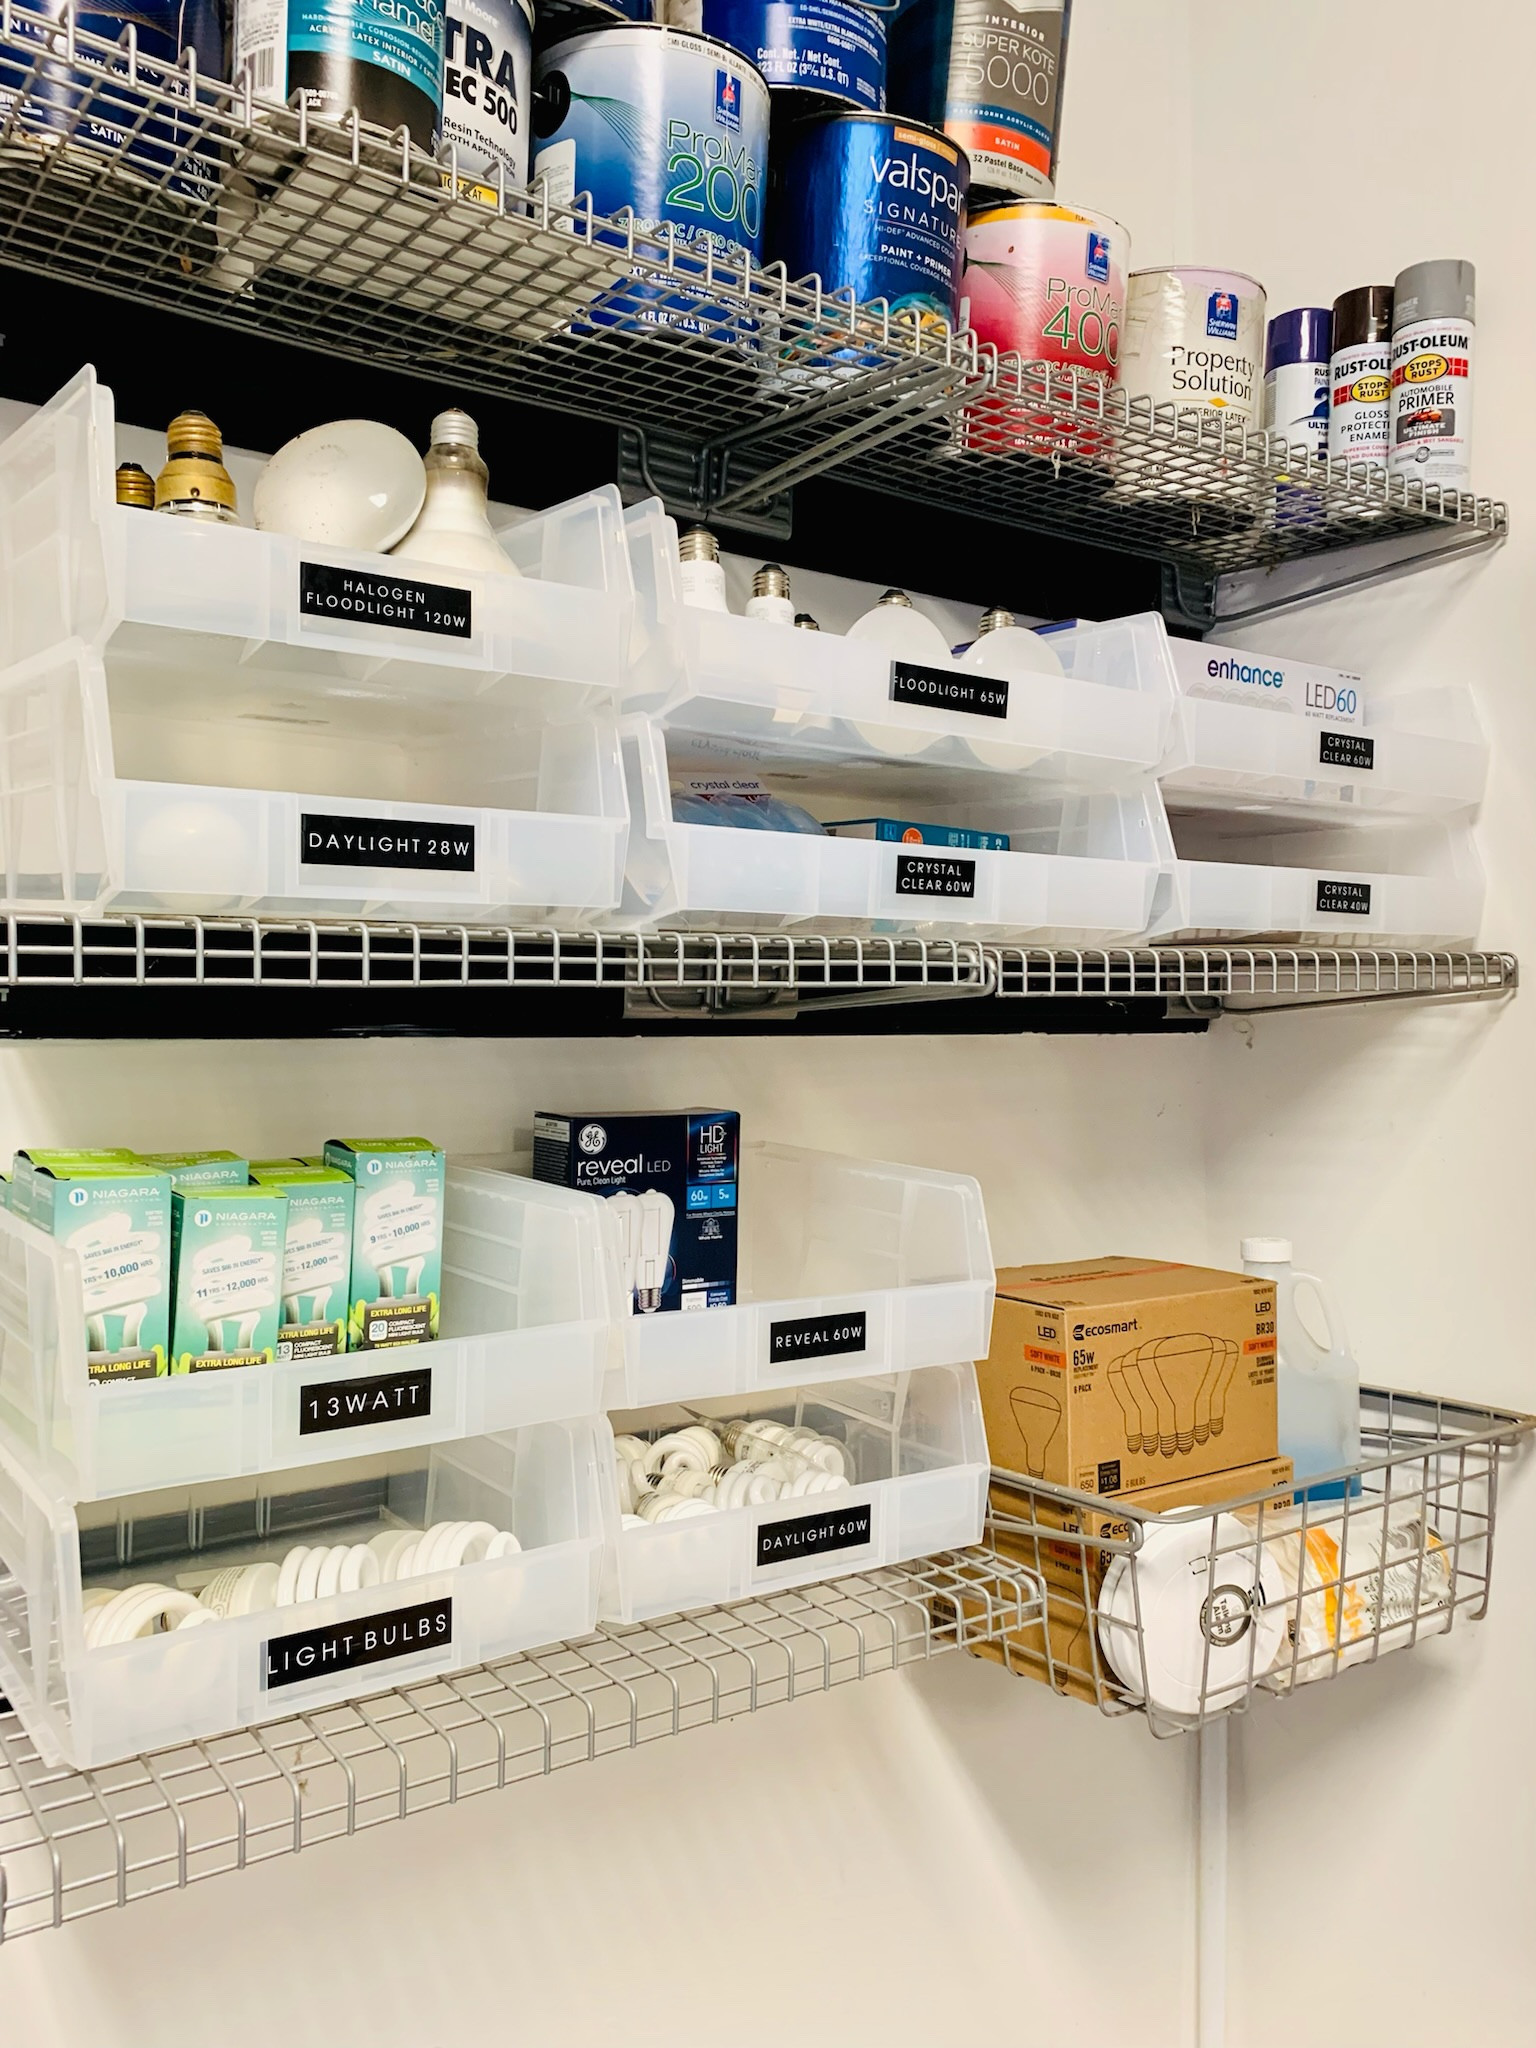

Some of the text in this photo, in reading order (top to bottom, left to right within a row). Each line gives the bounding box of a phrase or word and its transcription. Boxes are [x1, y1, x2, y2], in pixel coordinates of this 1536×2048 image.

[464, 1, 499, 28] Moore
[985, 14, 1045, 42] INTERIOR
[351, 31, 418, 67] LATEX INTERIOR
[961, 32, 1055, 76] SUPER KOTE
[372, 50, 411, 78] SATIN
[757, 47, 779, 60] Cont.
[782, 48, 800, 60] Net.
[807, 51, 822, 62] Net
[823, 53, 842, 70] Cont.
[775, 61, 784, 72] FL
[787, 62, 797, 73] OZ
[820, 66, 836, 81] U.S.
[963, 53, 1049, 106] 5000
[483, 84, 518, 136] 500
[443, 116, 517, 170] Resin Technology
[897, 131, 937, 150] semi-gloss
[995, 137, 1021, 151] SATIN
[984, 155, 1007, 169] Pastel
[1008, 162, 1024, 174] Base
[869, 153, 965, 217] valspar
[665, 153, 760, 239] 200
[863, 199, 962, 250] SIGNATURE
[905, 230, 940, 253] ADVANCED
[860, 253, 941, 283] EXCEPTIONAL COVERAGE
[881, 244, 914, 261] PAINT
[924, 255, 951, 279] PRIMER
[1208, 317, 1238, 330] SHERWIN
[1042, 305, 1120, 366] 400
[1207, 326, 1237, 339] WILLIAMS
[1171, 346, 1255, 382] Property
[1409, 358, 1442, 372] STOPS
[1411, 367, 1438, 380] RUST
[1358, 381, 1389, 391] STOPS
[1360, 389, 1386, 398] RUST
[1400, 384, 1453, 399] AUTOMOBILE
[1399, 391, 1454, 413] PRIMER
[1225, 409, 1246, 423] LATEX
[1354, 410, 1389, 420] GLOSS
[1403, 422, 1446, 434] ULTIMATE
[1408, 428, 1439, 438] FINISH
[343, 579, 426, 604] HALOGEN
[306, 592, 466, 628] FLOODLIGHT 120W
[1207, 658, 1284, 689] enhance
[894, 676, 1006, 705] FLOODLIGHT 65W
[1305, 682, 1357, 714] LED60
[1327, 736, 1366, 752] CRYSTAL
[1322, 750, 1372, 767] CLEAR 60W
[690, 780, 760, 791] crystal clear
[309, 832, 470, 856] DAYLIGHT 28W
[907, 861, 962, 877] CRYSTAL
[901, 877, 972, 893] CLEAR 60W
[1324, 884, 1363, 898] CRYSTAL
[1319, 898, 1369, 911] CLEAR 40W
[700, 1125, 727, 1144] HD
[700, 1143, 724, 1154] LIGHT
[385, 1159, 437, 1169] NIAGARA
[577, 1153, 672, 1177] reveal LED
[180, 1170, 239, 1181] NIAGARA
[576, 1175, 627, 1187] Pure, Clean Light
[92, 1187, 161, 1199] NIAGARA
[290, 1196, 345, 1207] NIAGARA
[215, 1212, 277, 1221] NIAGARA
[370, 1235, 376, 1244] 9
[392, 1222, 420, 1237] 10,000
[104, 1261, 139, 1279] 10,000
[301, 1256, 328, 1271] 12,000
[196, 1288, 208, 1298] 11
[226, 1277, 257, 1291] 12,000
[371, 1305, 427, 1318] EXTRA LONG LIFE
[1255, 1301, 1272, 1313] LED
[372, 1323, 385, 1333] 20
[388, 1319, 415, 1327] COMPACT
[388, 1323, 426, 1333] FLUORESCENT
[1256, 1321, 1275, 1335] BR30
[300, 1326, 335, 1337] LONG LIFE
[775, 1326, 863, 1349] REVEAL 60W
[1037, 1325, 1057, 1339] LED
[277, 1344, 290, 1354] 13
[294, 1340, 321, 1348] COMPACT
[294, 1344, 334, 1353] FLUORESCENT
[1248, 1340, 1274, 1352] SOFT WHITE
[195, 1356, 262, 1368] EXTRA LONG LIFE
[1029, 1349, 1061, 1364] SOFT WHITE
[108, 1359, 151, 1372] LONG LIFE
[1078, 1383, 1092, 1394] PACK
[763, 1519, 868, 1551] DAYLIGHT 60W
[267, 1613, 447, 1675] LIGHT BULBS
